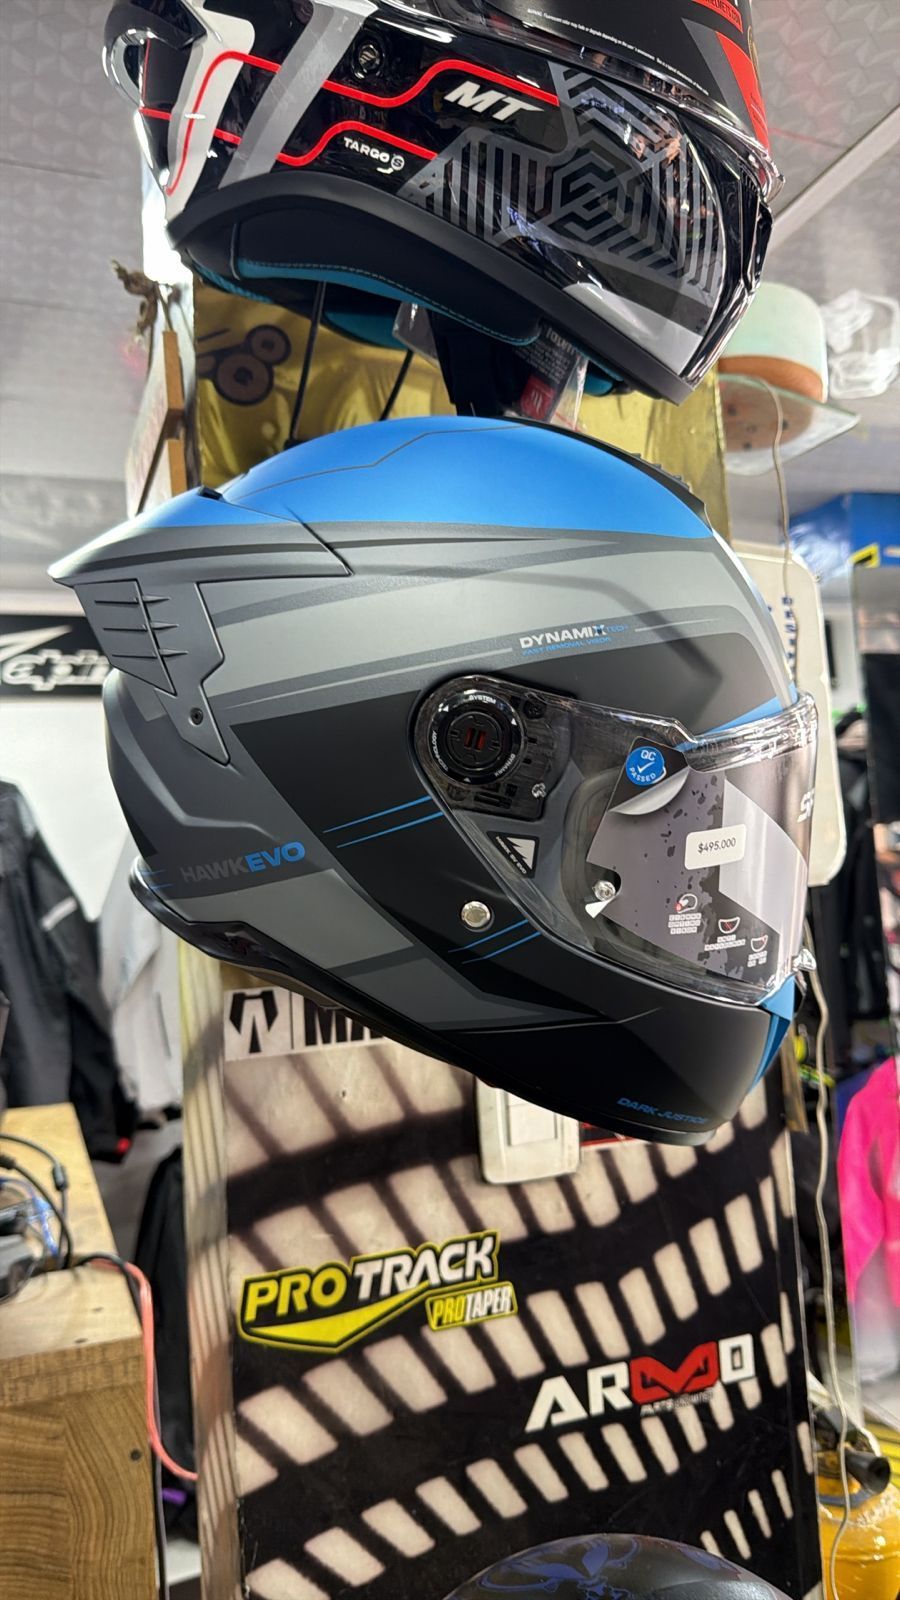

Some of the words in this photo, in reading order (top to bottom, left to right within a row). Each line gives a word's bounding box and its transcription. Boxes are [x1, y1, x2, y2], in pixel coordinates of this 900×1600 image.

[443, 80, 545, 122] MT
[343, 136, 390, 163] TARGO
[519, 624, 607, 649] DYNAMIX
[468, 693, 497, 705] SYSTEM
[640, 749, 656, 762] QC
[628, 766, 657, 783] PASSED
[697, 837, 737, 855] $495.000
[617, 1097, 658, 1115] DARK
[658, 1111, 706, 1125] JUSTICE
[432, 1285, 512, 1328] PROTAPER
